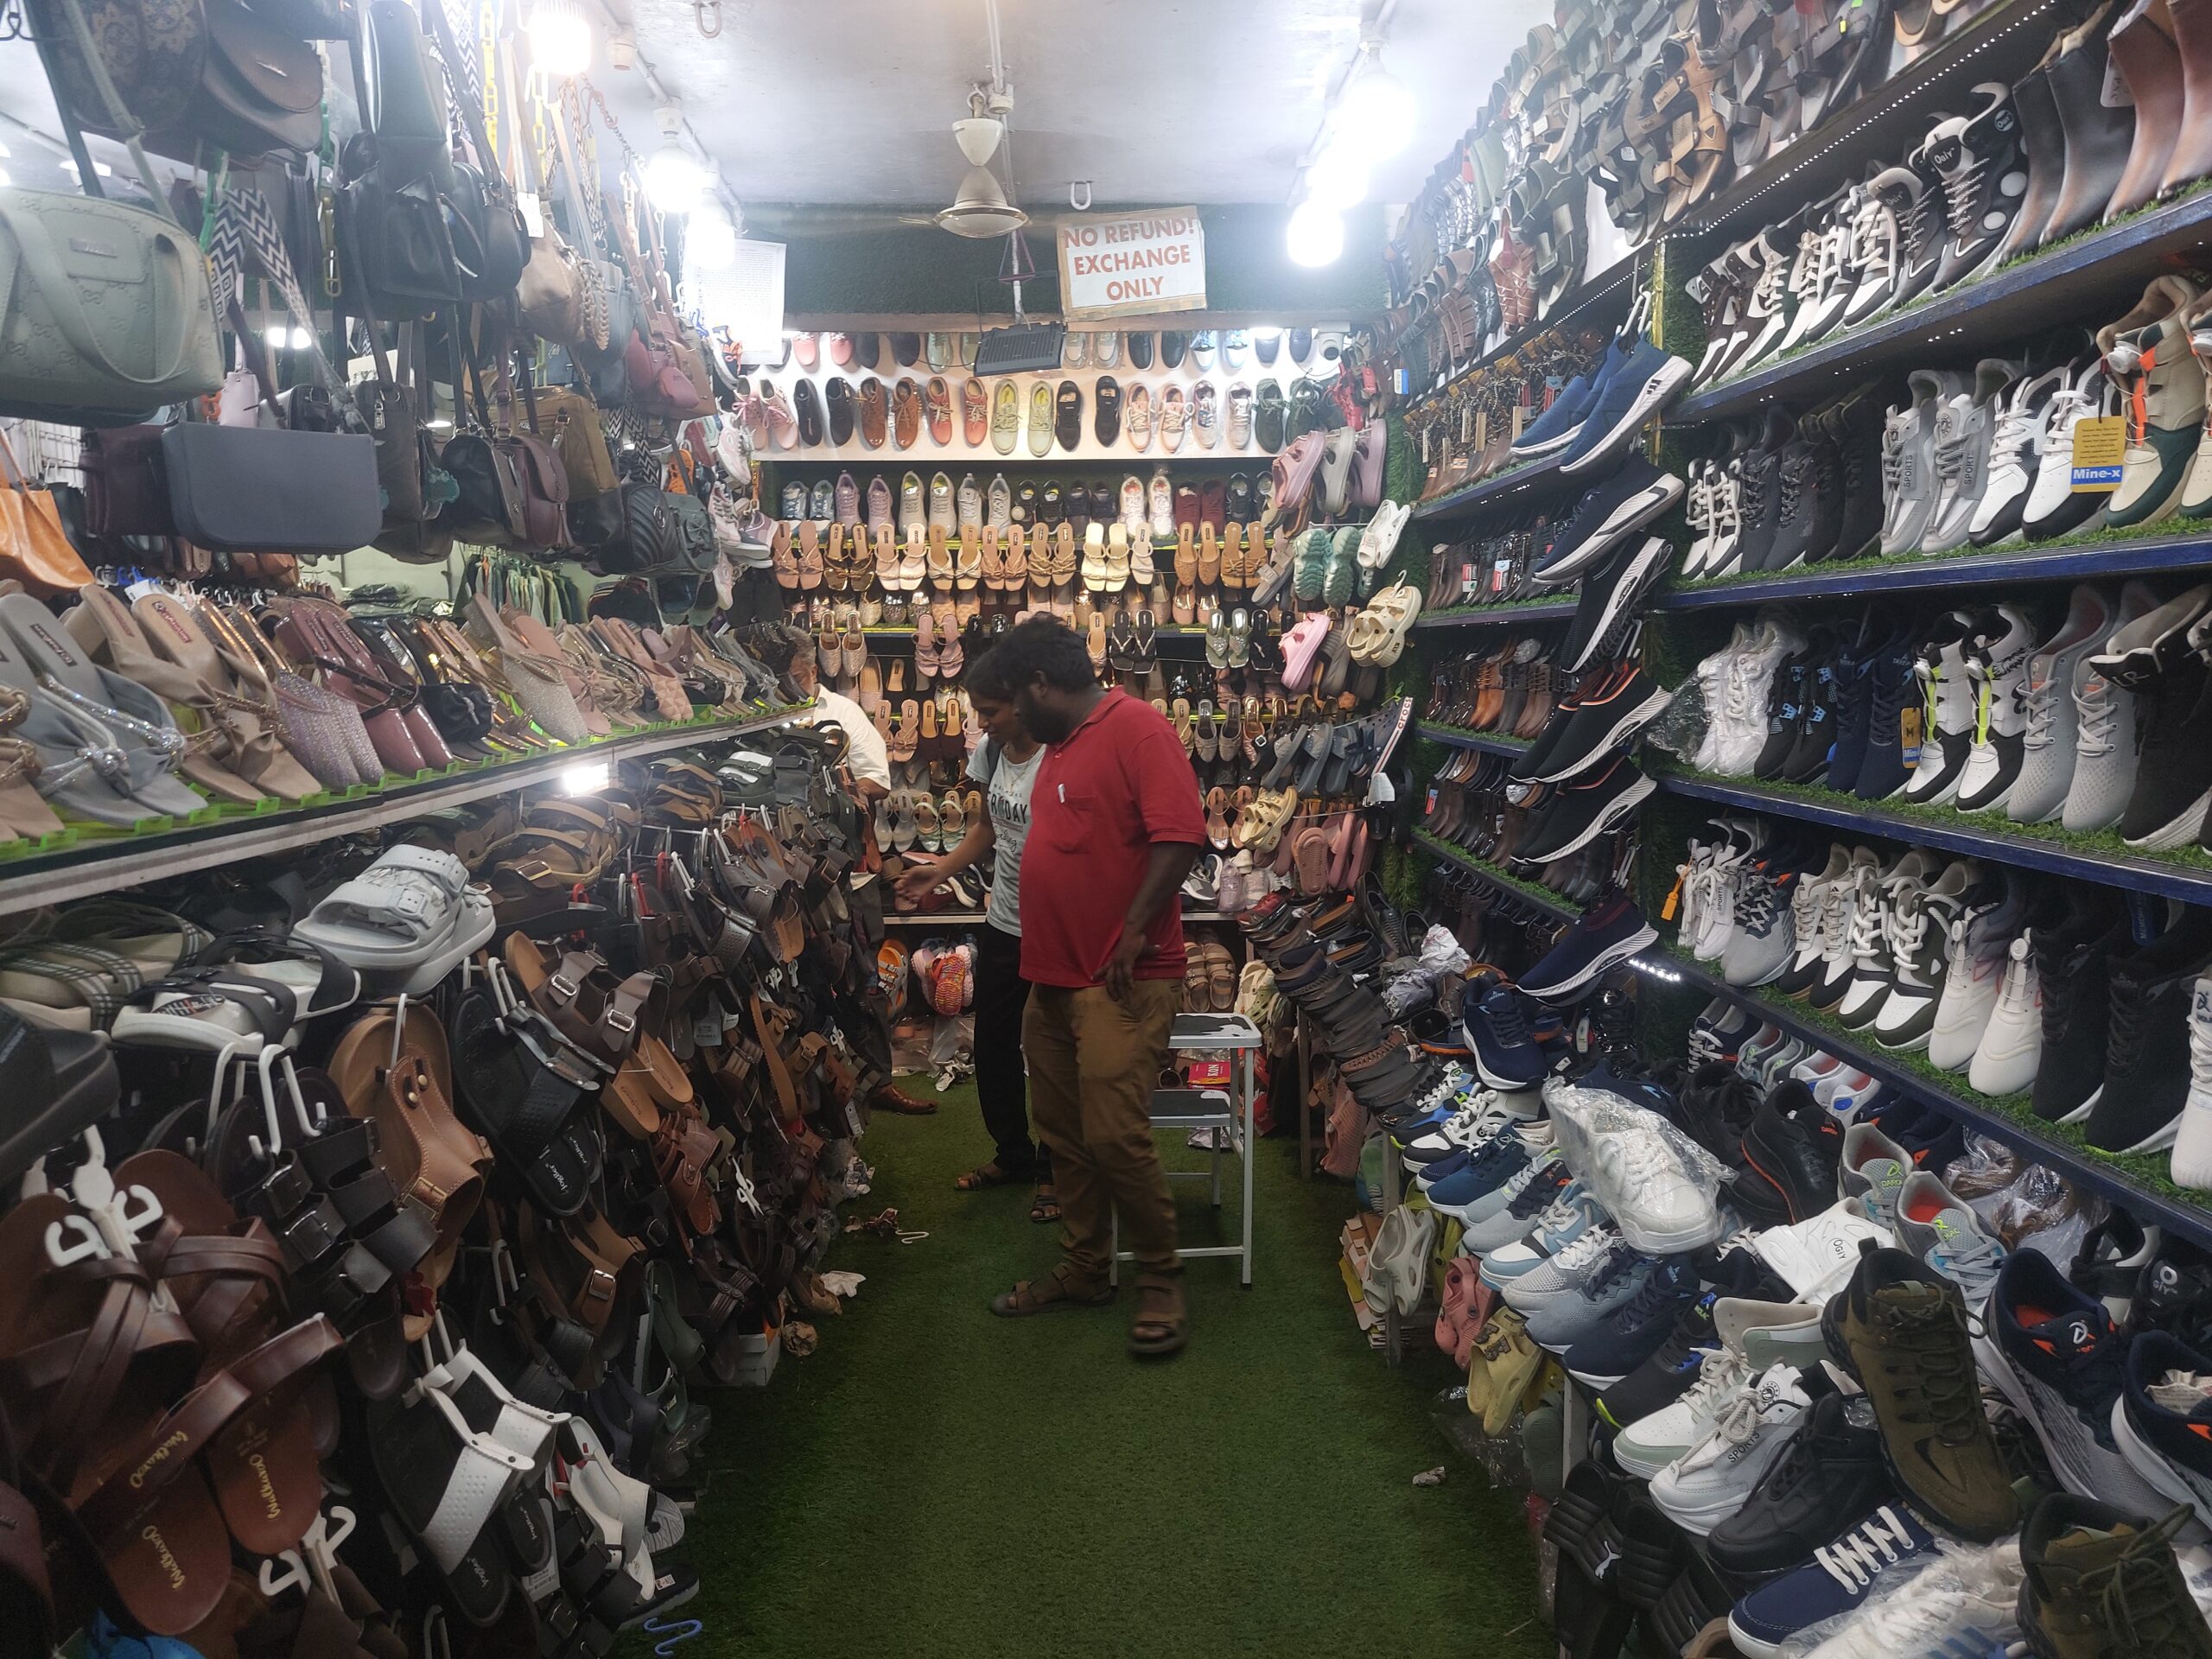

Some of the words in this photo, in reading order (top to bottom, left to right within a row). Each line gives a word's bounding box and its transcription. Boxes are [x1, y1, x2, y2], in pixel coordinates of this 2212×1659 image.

[1064, 227, 1098, 249] NO
[1105, 218, 1196, 245] REFUND!
[1074, 244, 1191, 276] EXCHANGE
[1106, 276, 1164, 301] ONLY
[1903, 454, 1913, 488] SPORTS
[2073, 468, 2121, 480] Mine-x
[1397, 697, 1412, 729] crocs
[1880, 1179, 1902, 1188] DARD
